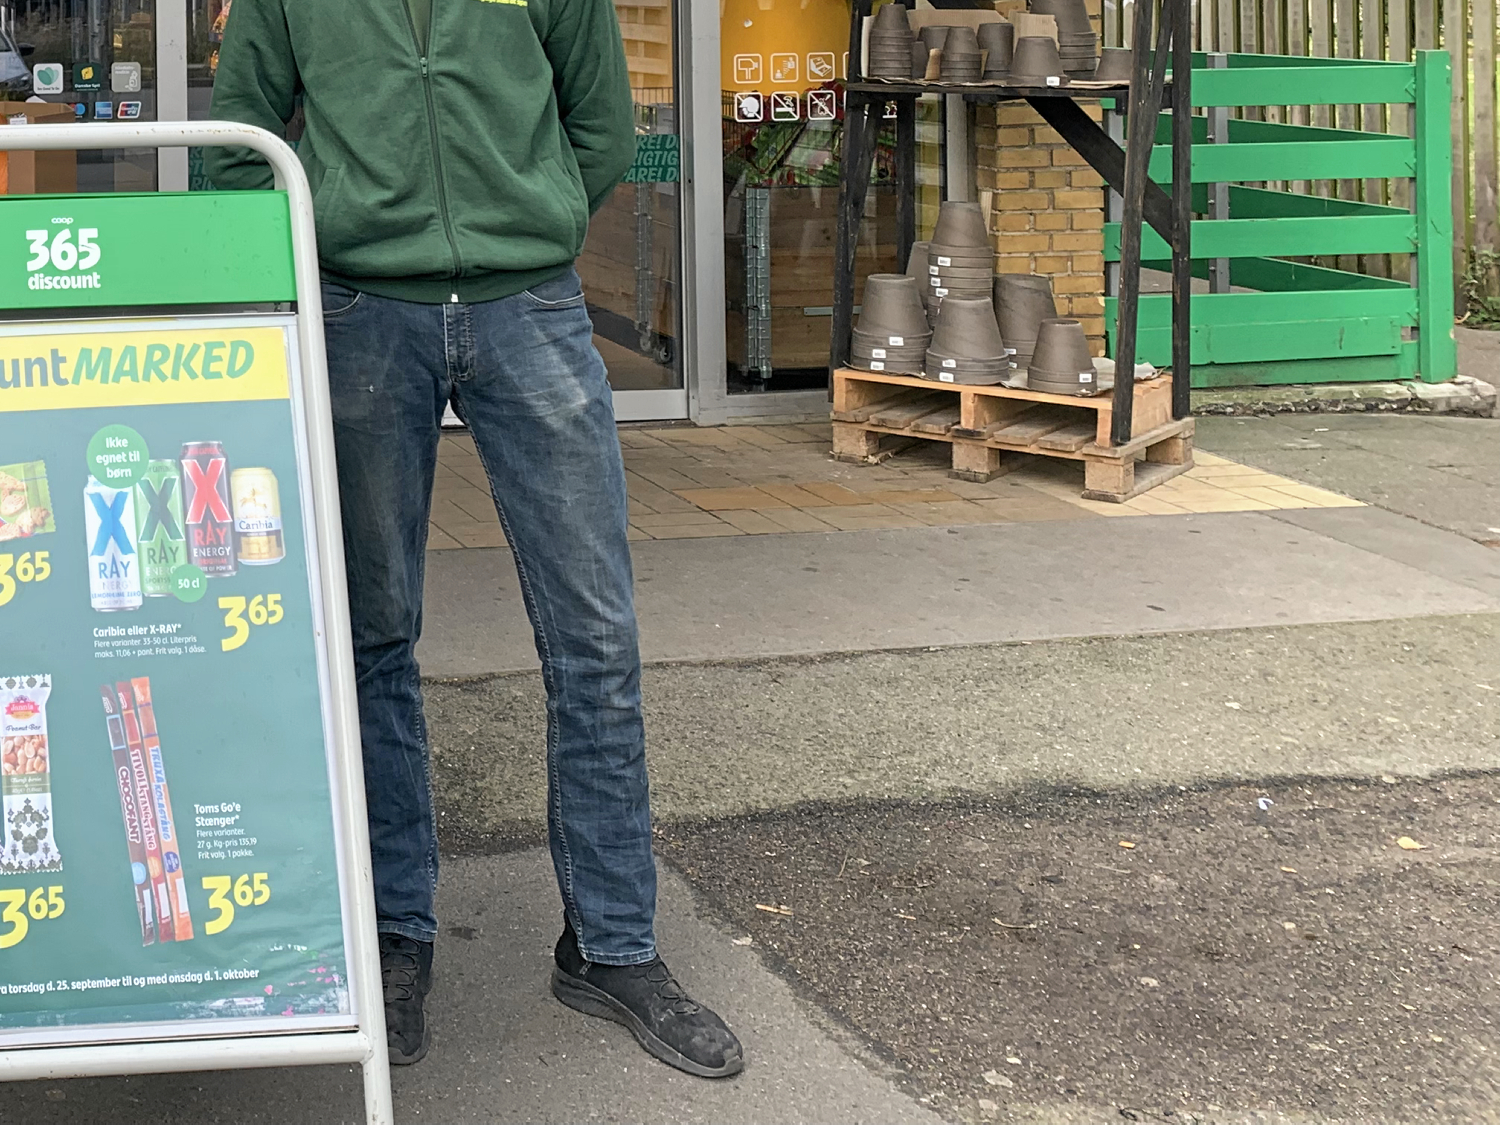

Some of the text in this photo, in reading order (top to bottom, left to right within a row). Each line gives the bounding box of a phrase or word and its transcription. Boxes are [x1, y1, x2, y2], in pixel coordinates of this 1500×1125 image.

[51, 217, 73, 225] coop
[25, 228, 101, 272] 365
[27, 272, 101, 290] discount
[106, 437, 129, 449] Ikke
[96, 450, 140, 465] egnet til
[106, 466, 132, 479] børn
[238, 519, 274, 531] Caribia
[194, 519, 227, 546] RAY
[146, 538, 179, 565] RAY
[193, 546, 231, 558] ENERGY
[97, 553, 131, 579] RAY
[178, 578, 200, 589] 50 cl
[93, 626, 126, 637] Caribia
[127, 625, 148, 636] eller
[94, 640, 110, 648] Flere
[111, 638, 142, 647] varianter.
[143, 637, 161, 645] 33-50
[170, 635, 197, 645] Literpris
[94, 650, 114, 658] maks.
[115, 649, 131, 657] 11,06
[137, 648, 155, 657] pant.
[155, 647, 166, 655] Frit
[167, 646, 183, 655] valg.
[188, 645, 206, 653] dåse.
[117, 765, 141, 844] CHOCOFANT
[194, 804, 219, 814] Toms
[196, 828, 246, 837] Flere varianter.
[197, 840, 205, 848] 27
[213, 838, 238, 849] Kg-pris
[239, 837, 257, 847] 135,19
[198, 851, 210, 859] Frit
[210, 850, 227, 860] valg.
[232, 849, 255, 859] pakke.
[8, 982, 45, 997] torsdag
[46, 980, 56, 992] d.
[56, 979, 70, 992] 25.
[71, 976, 121, 993] september
[122, 975, 132, 987] til
[133, 977, 146, 988] og
[147, 973, 168, 985] med
[169, 971, 203, 985] onsdag
[204, 969, 213, 981] d.
[214, 969, 222, 981] 1.
[222, 967, 260, 981] oktober
